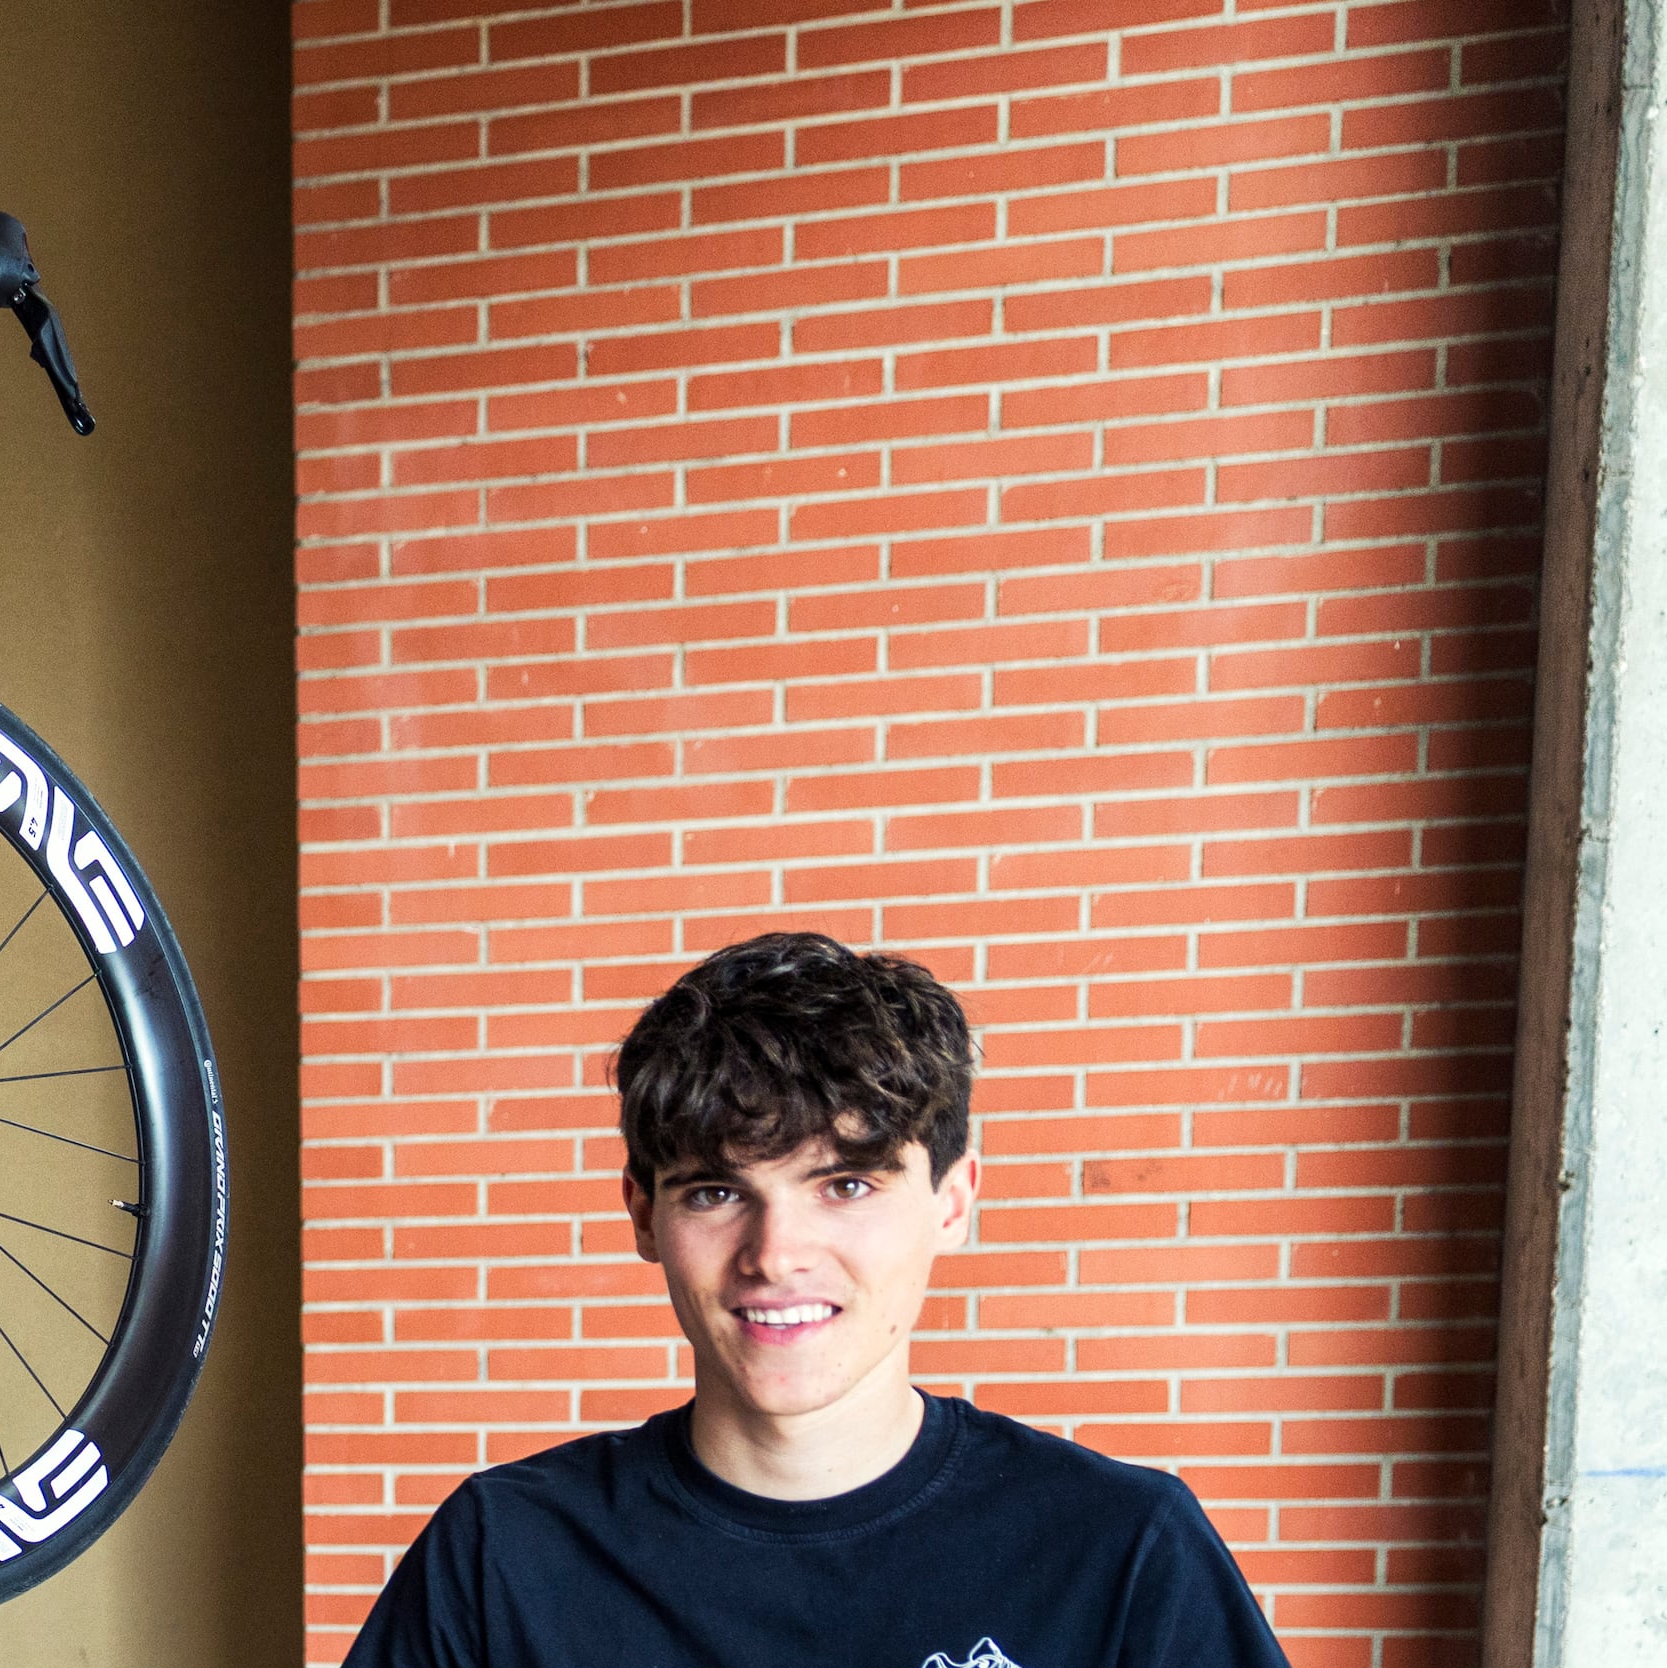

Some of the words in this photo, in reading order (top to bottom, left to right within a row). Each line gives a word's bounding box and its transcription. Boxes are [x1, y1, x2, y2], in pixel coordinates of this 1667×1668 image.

[212, 1110, 226, 1194] GRAND
[213, 1193, 227, 1250] PRIX
[204, 1250, 222, 1316] 5000
